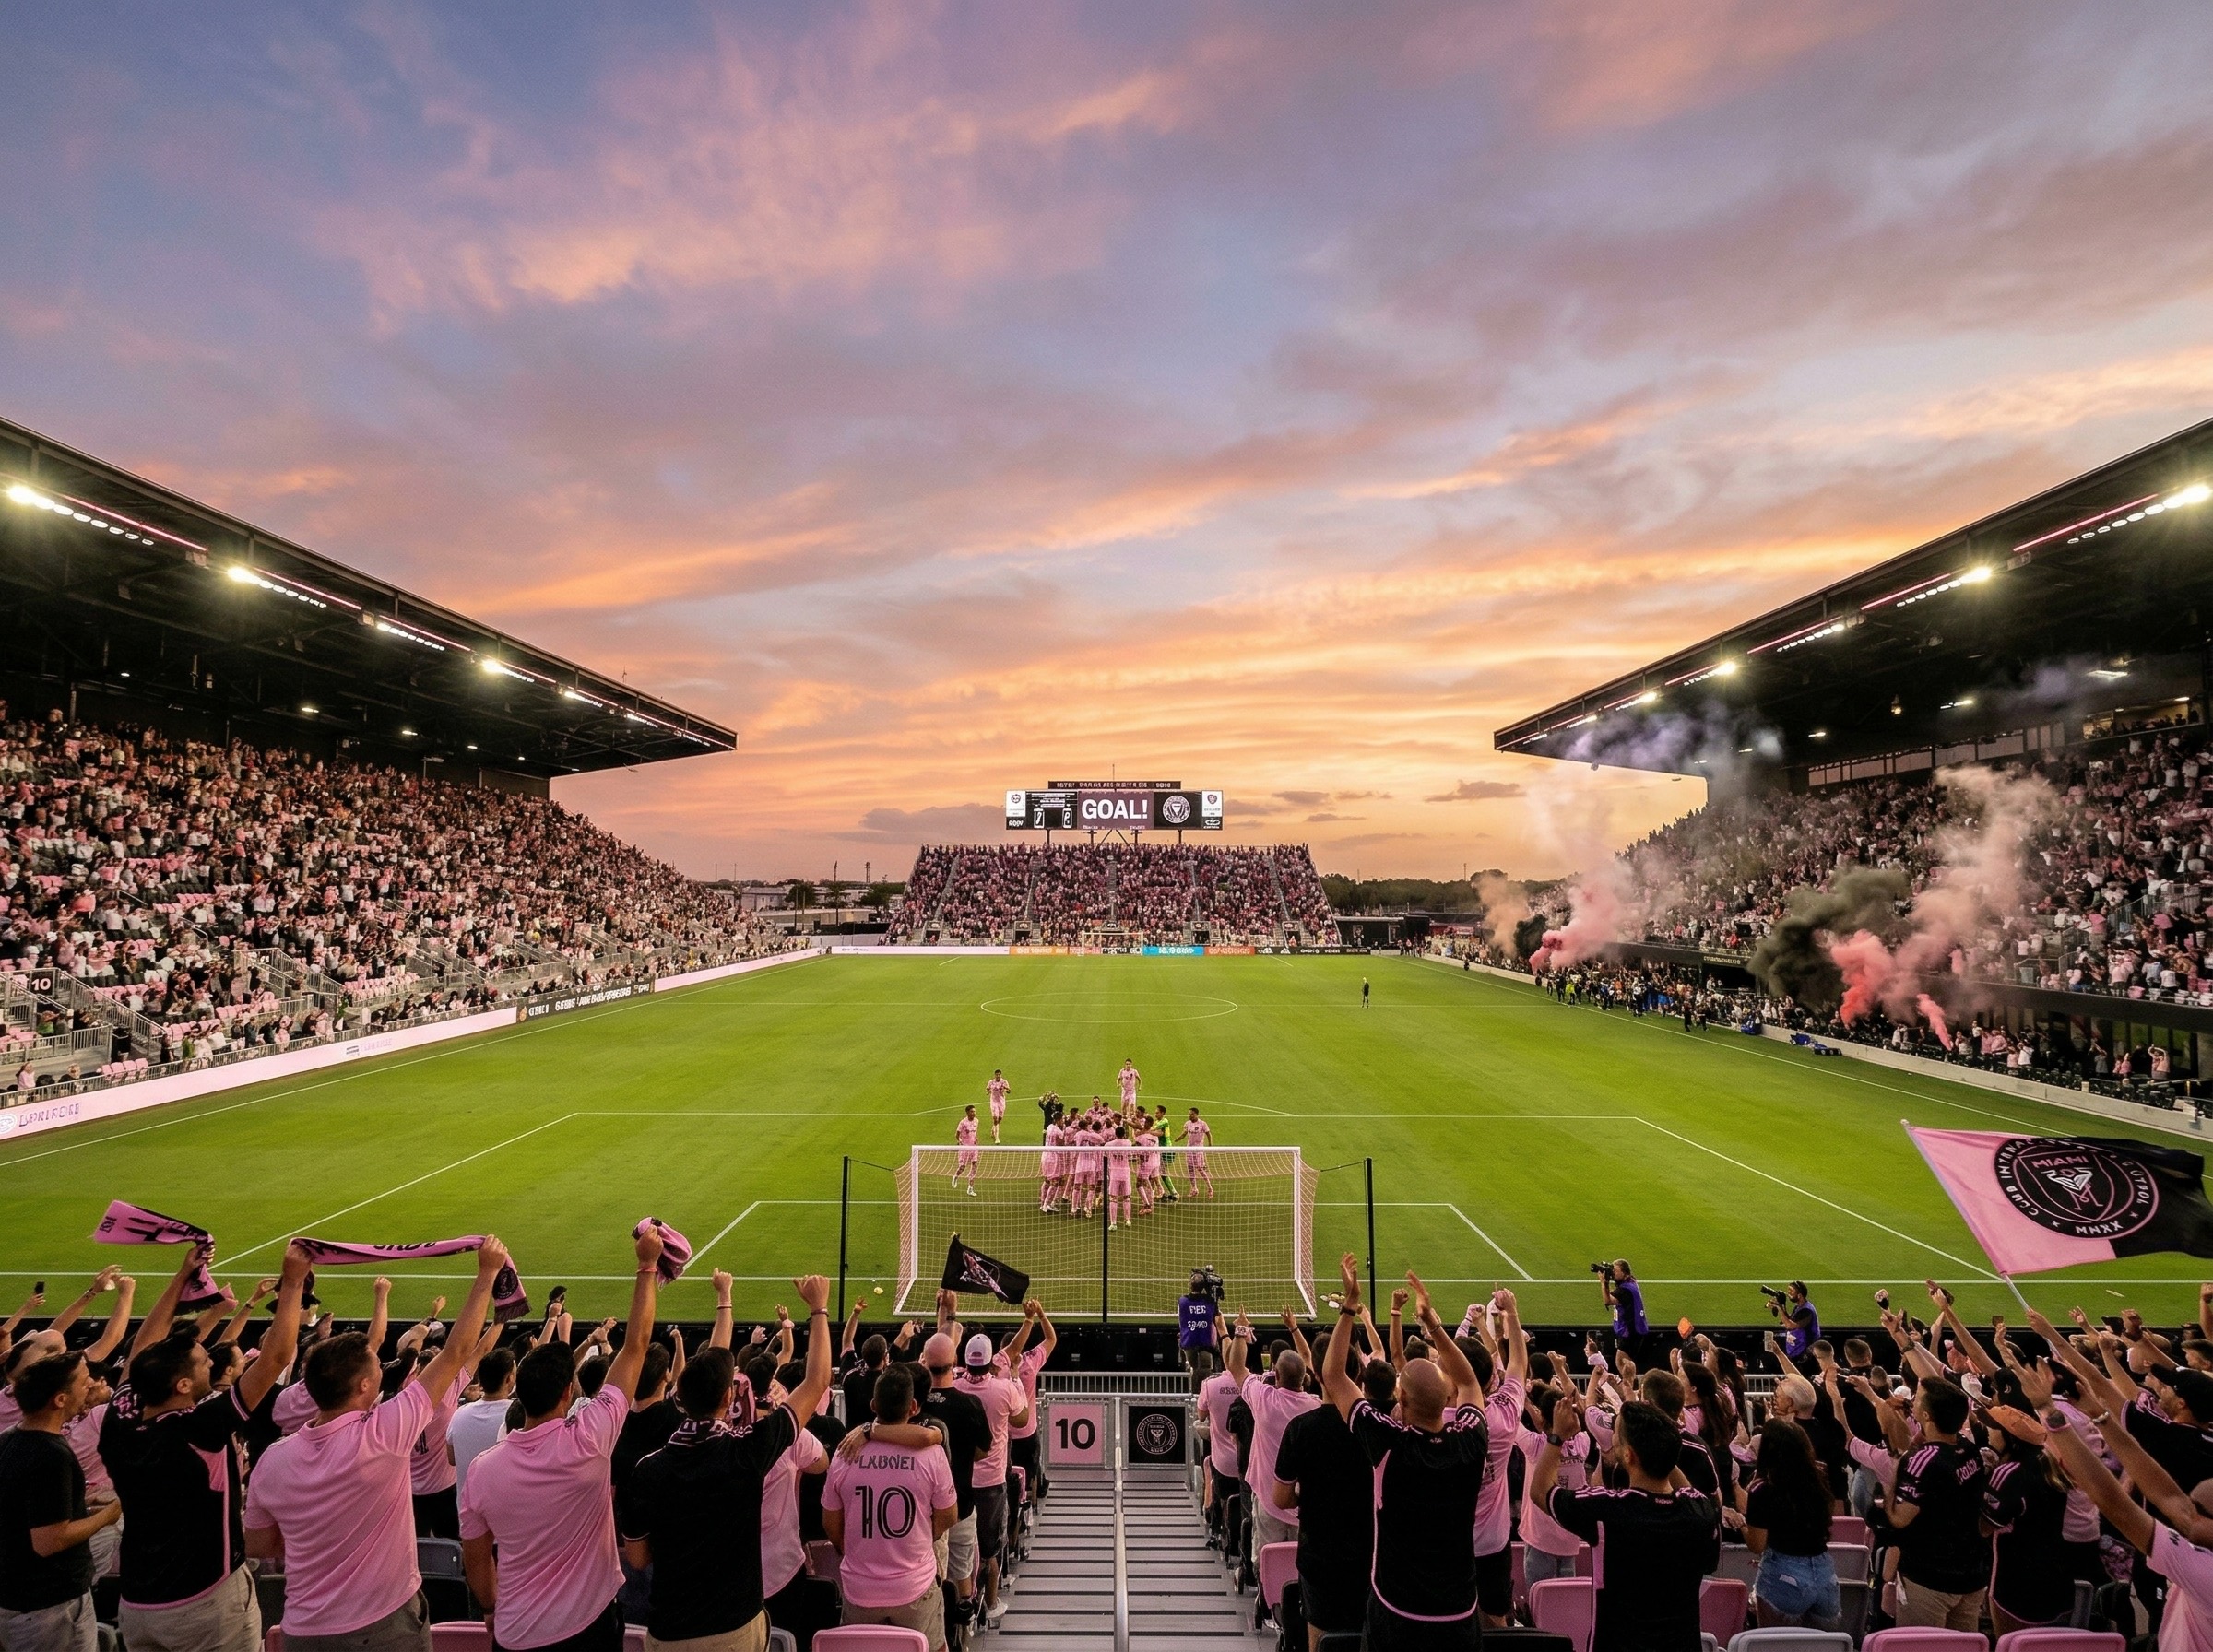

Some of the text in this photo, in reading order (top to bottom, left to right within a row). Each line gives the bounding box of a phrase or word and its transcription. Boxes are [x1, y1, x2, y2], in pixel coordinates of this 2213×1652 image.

[1082, 799, 1147, 820] GOAL!
[31, 977, 51, 991] 10
[2030, 1155, 2089, 1169] MIAMI
[1055, 1418, 1096, 1450] 10
[855, 1485, 917, 1540] 10
